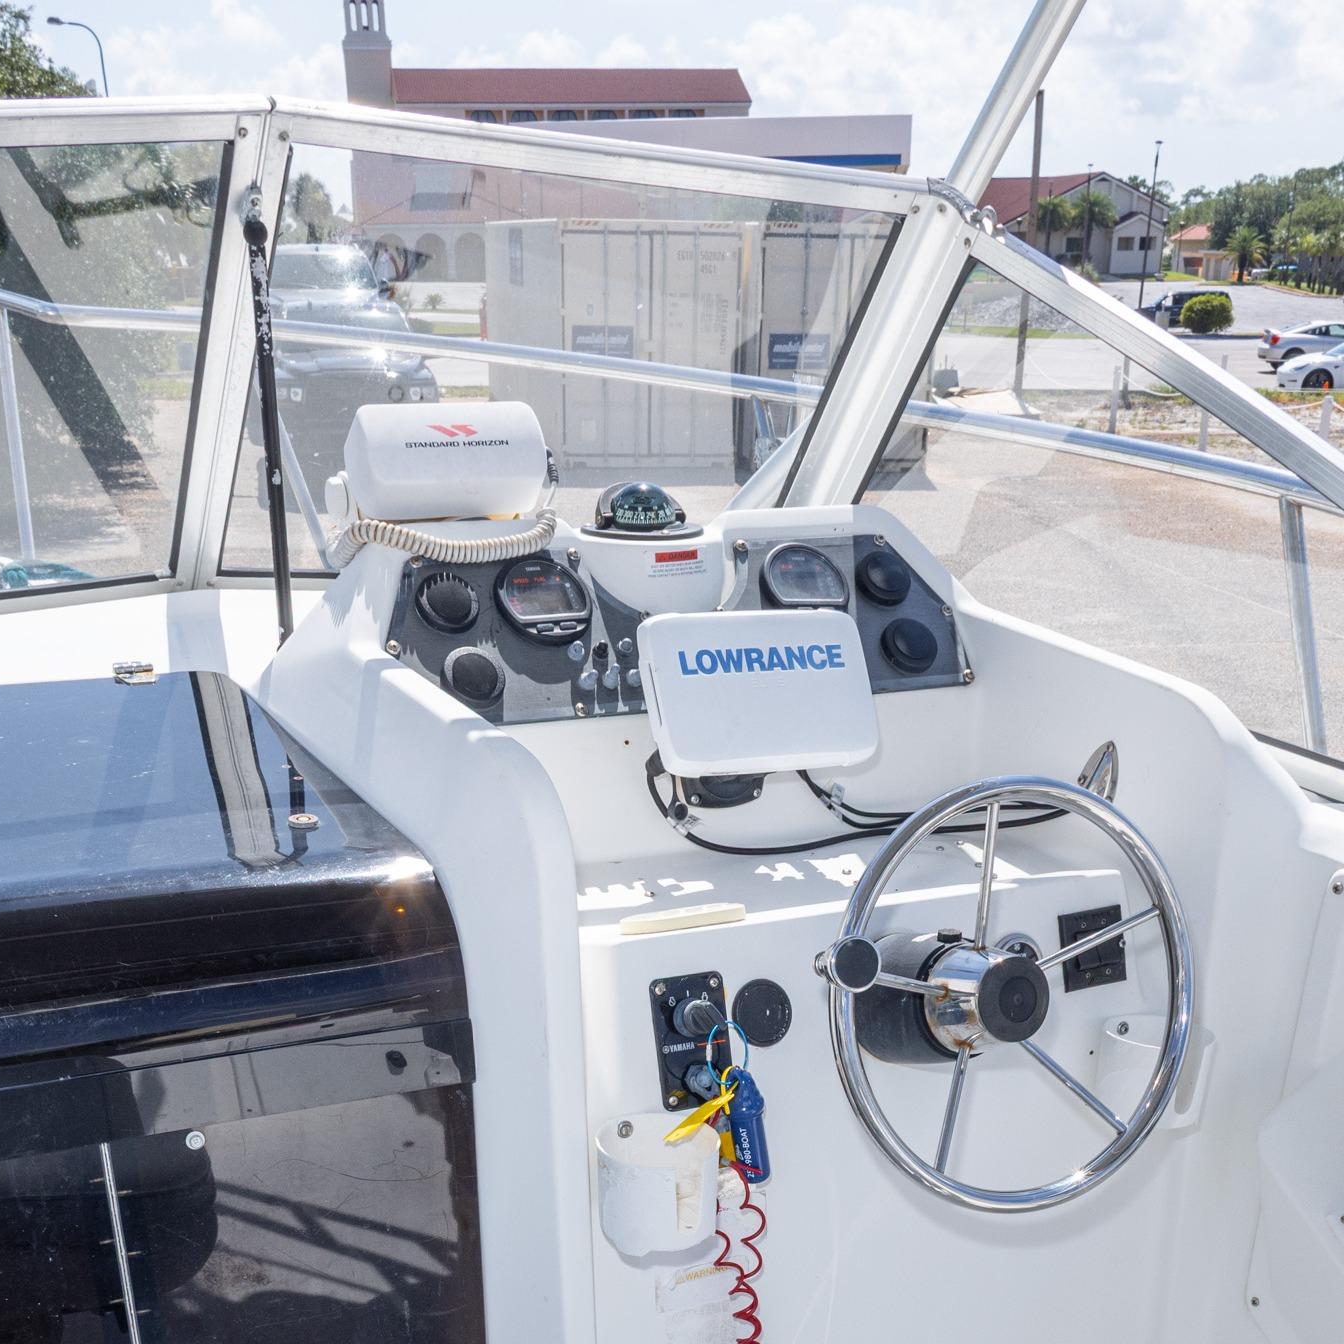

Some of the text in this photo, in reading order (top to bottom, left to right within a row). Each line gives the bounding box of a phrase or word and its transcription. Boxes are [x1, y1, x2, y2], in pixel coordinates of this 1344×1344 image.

[405, 439, 510, 449] STANDARD HORIZON
[669, 550, 696, 560] DANGER
[678, 644, 846, 676] LOWRANCE
[670, 1042, 695, 1053] YAMAHA
